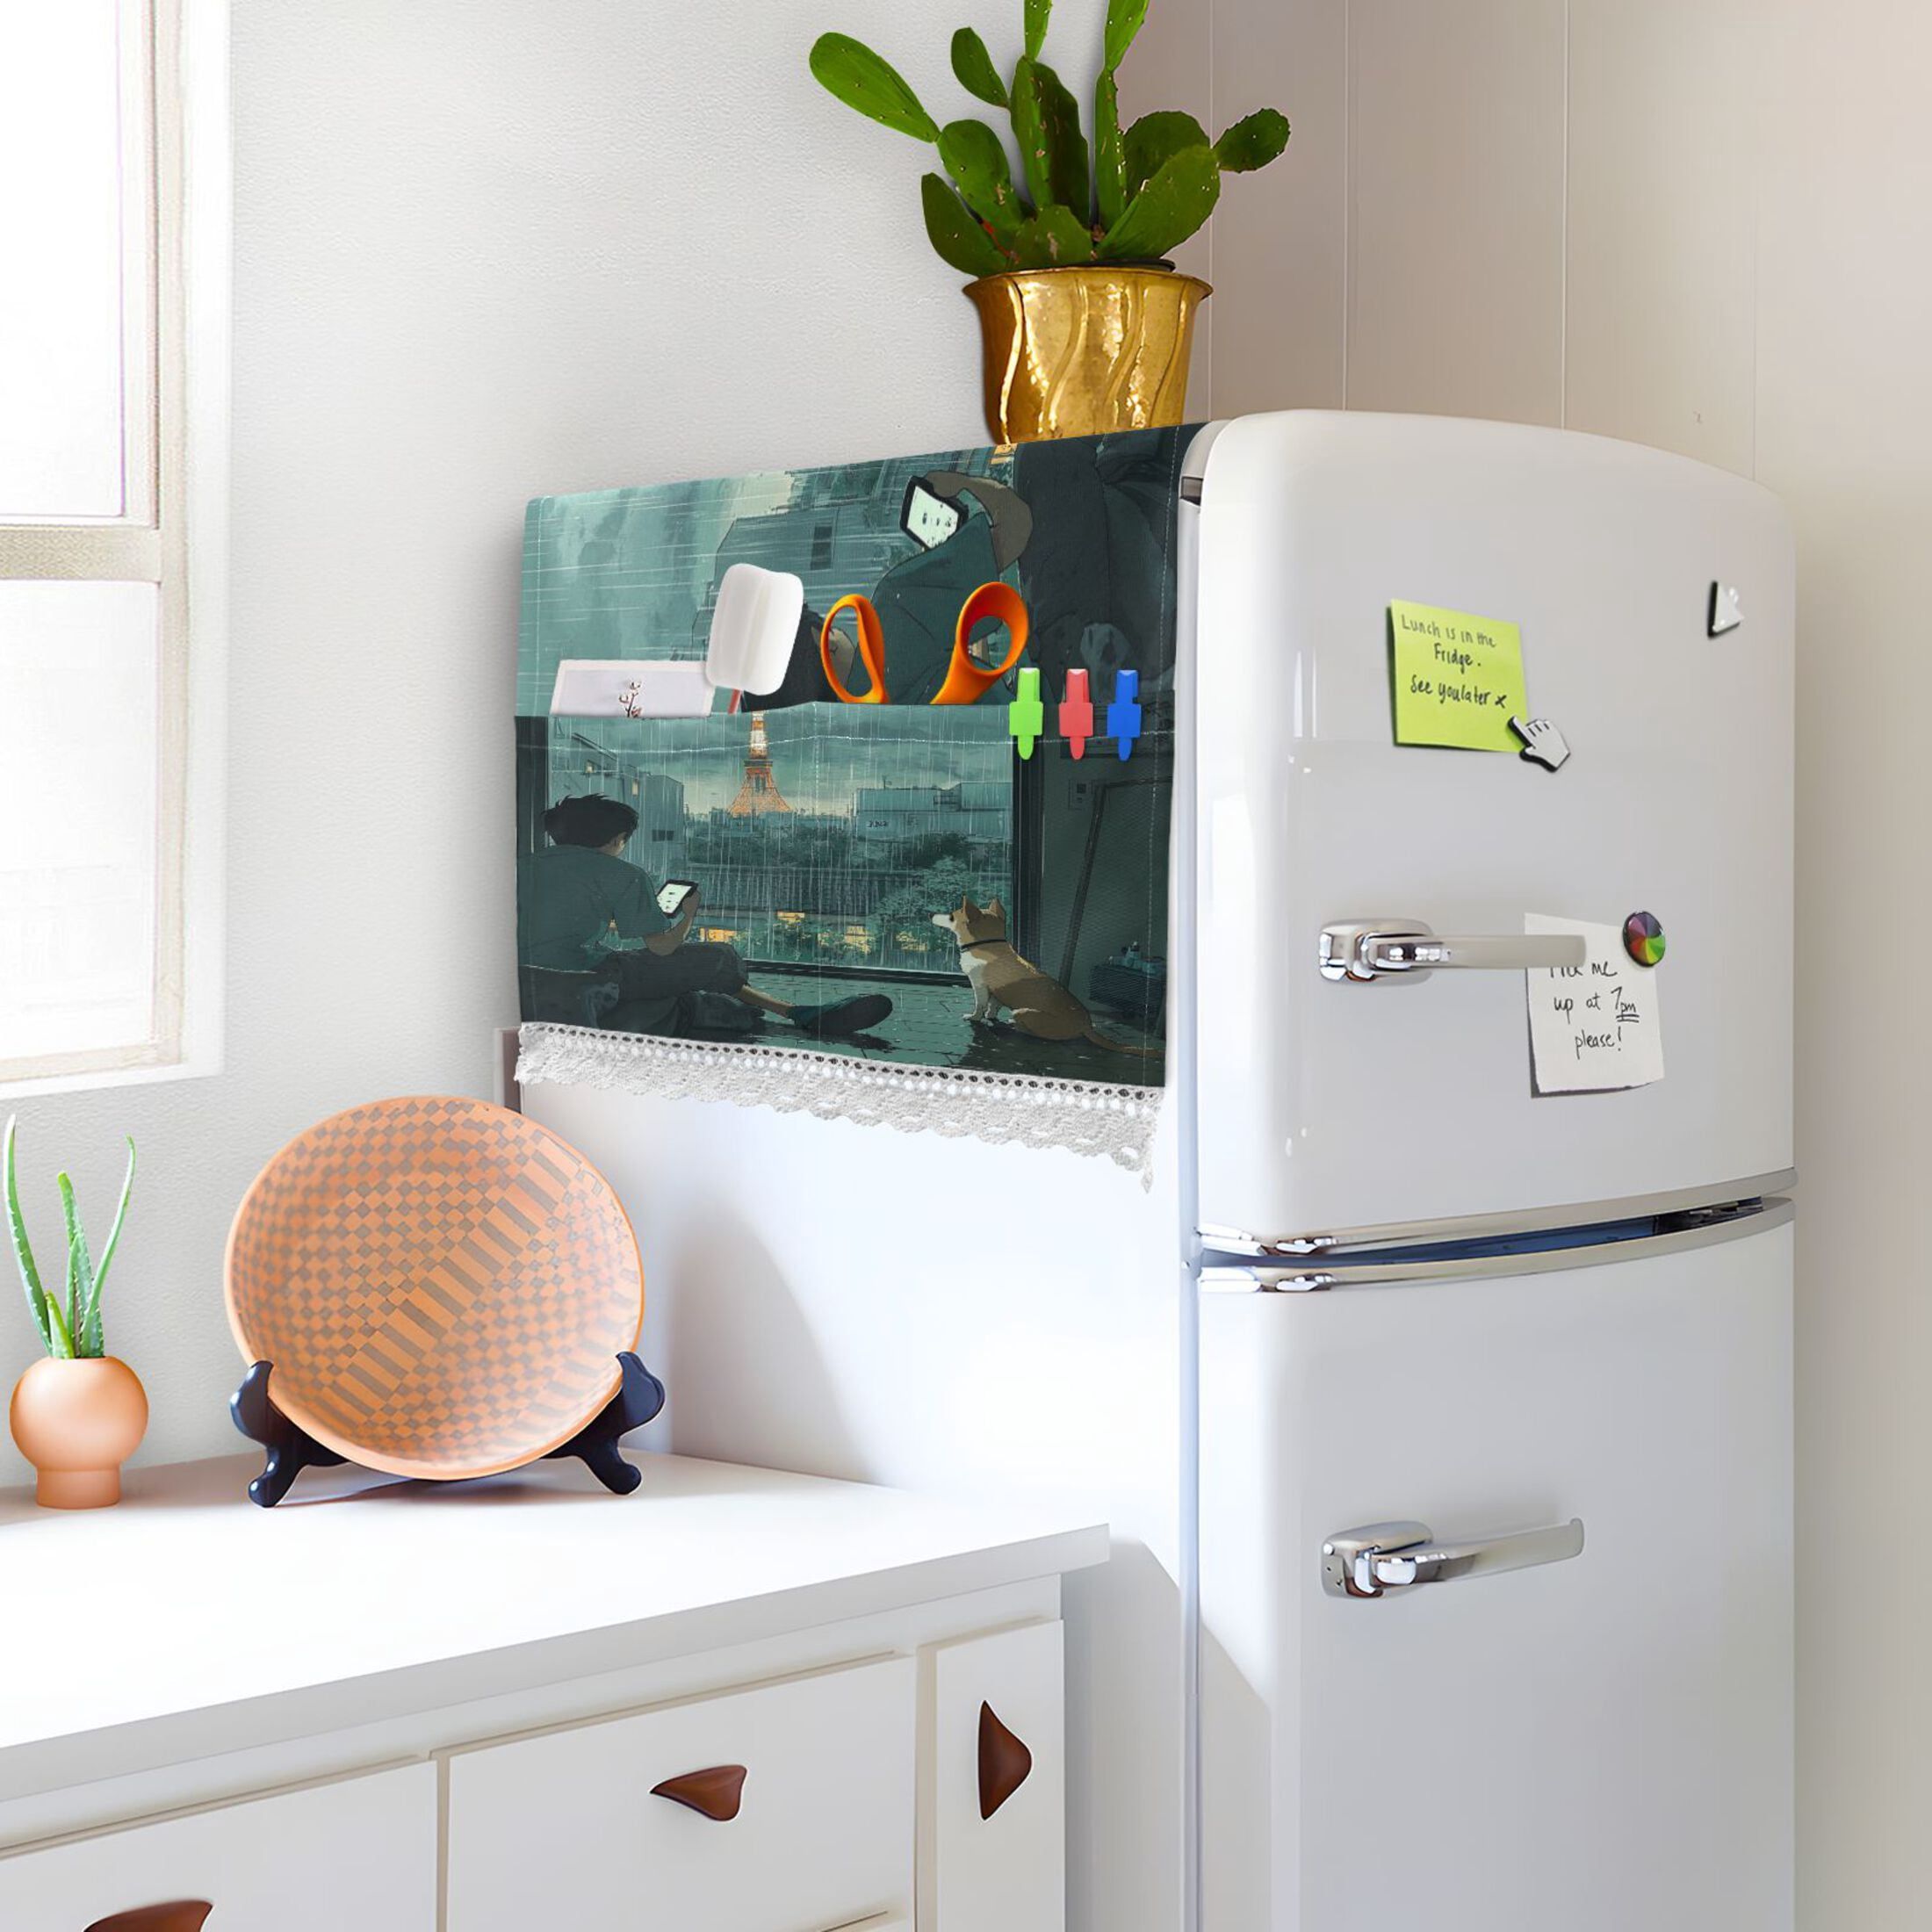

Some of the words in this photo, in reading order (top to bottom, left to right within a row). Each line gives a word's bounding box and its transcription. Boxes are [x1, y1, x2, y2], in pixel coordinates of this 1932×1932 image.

[1402, 613, 1441, 638] Lunch
[1445, 627, 1456, 641] is
[1460, 631, 1474, 644] in
[1476, 631, 1497, 648] the
[1410, 674, 1433, 695] See
[1592, 961, 1618, 977] me
[1554, 997, 1574, 1025] up
[1586, 992, 1601, 1011] at
[1575, 1026, 1622, 1060] please!
